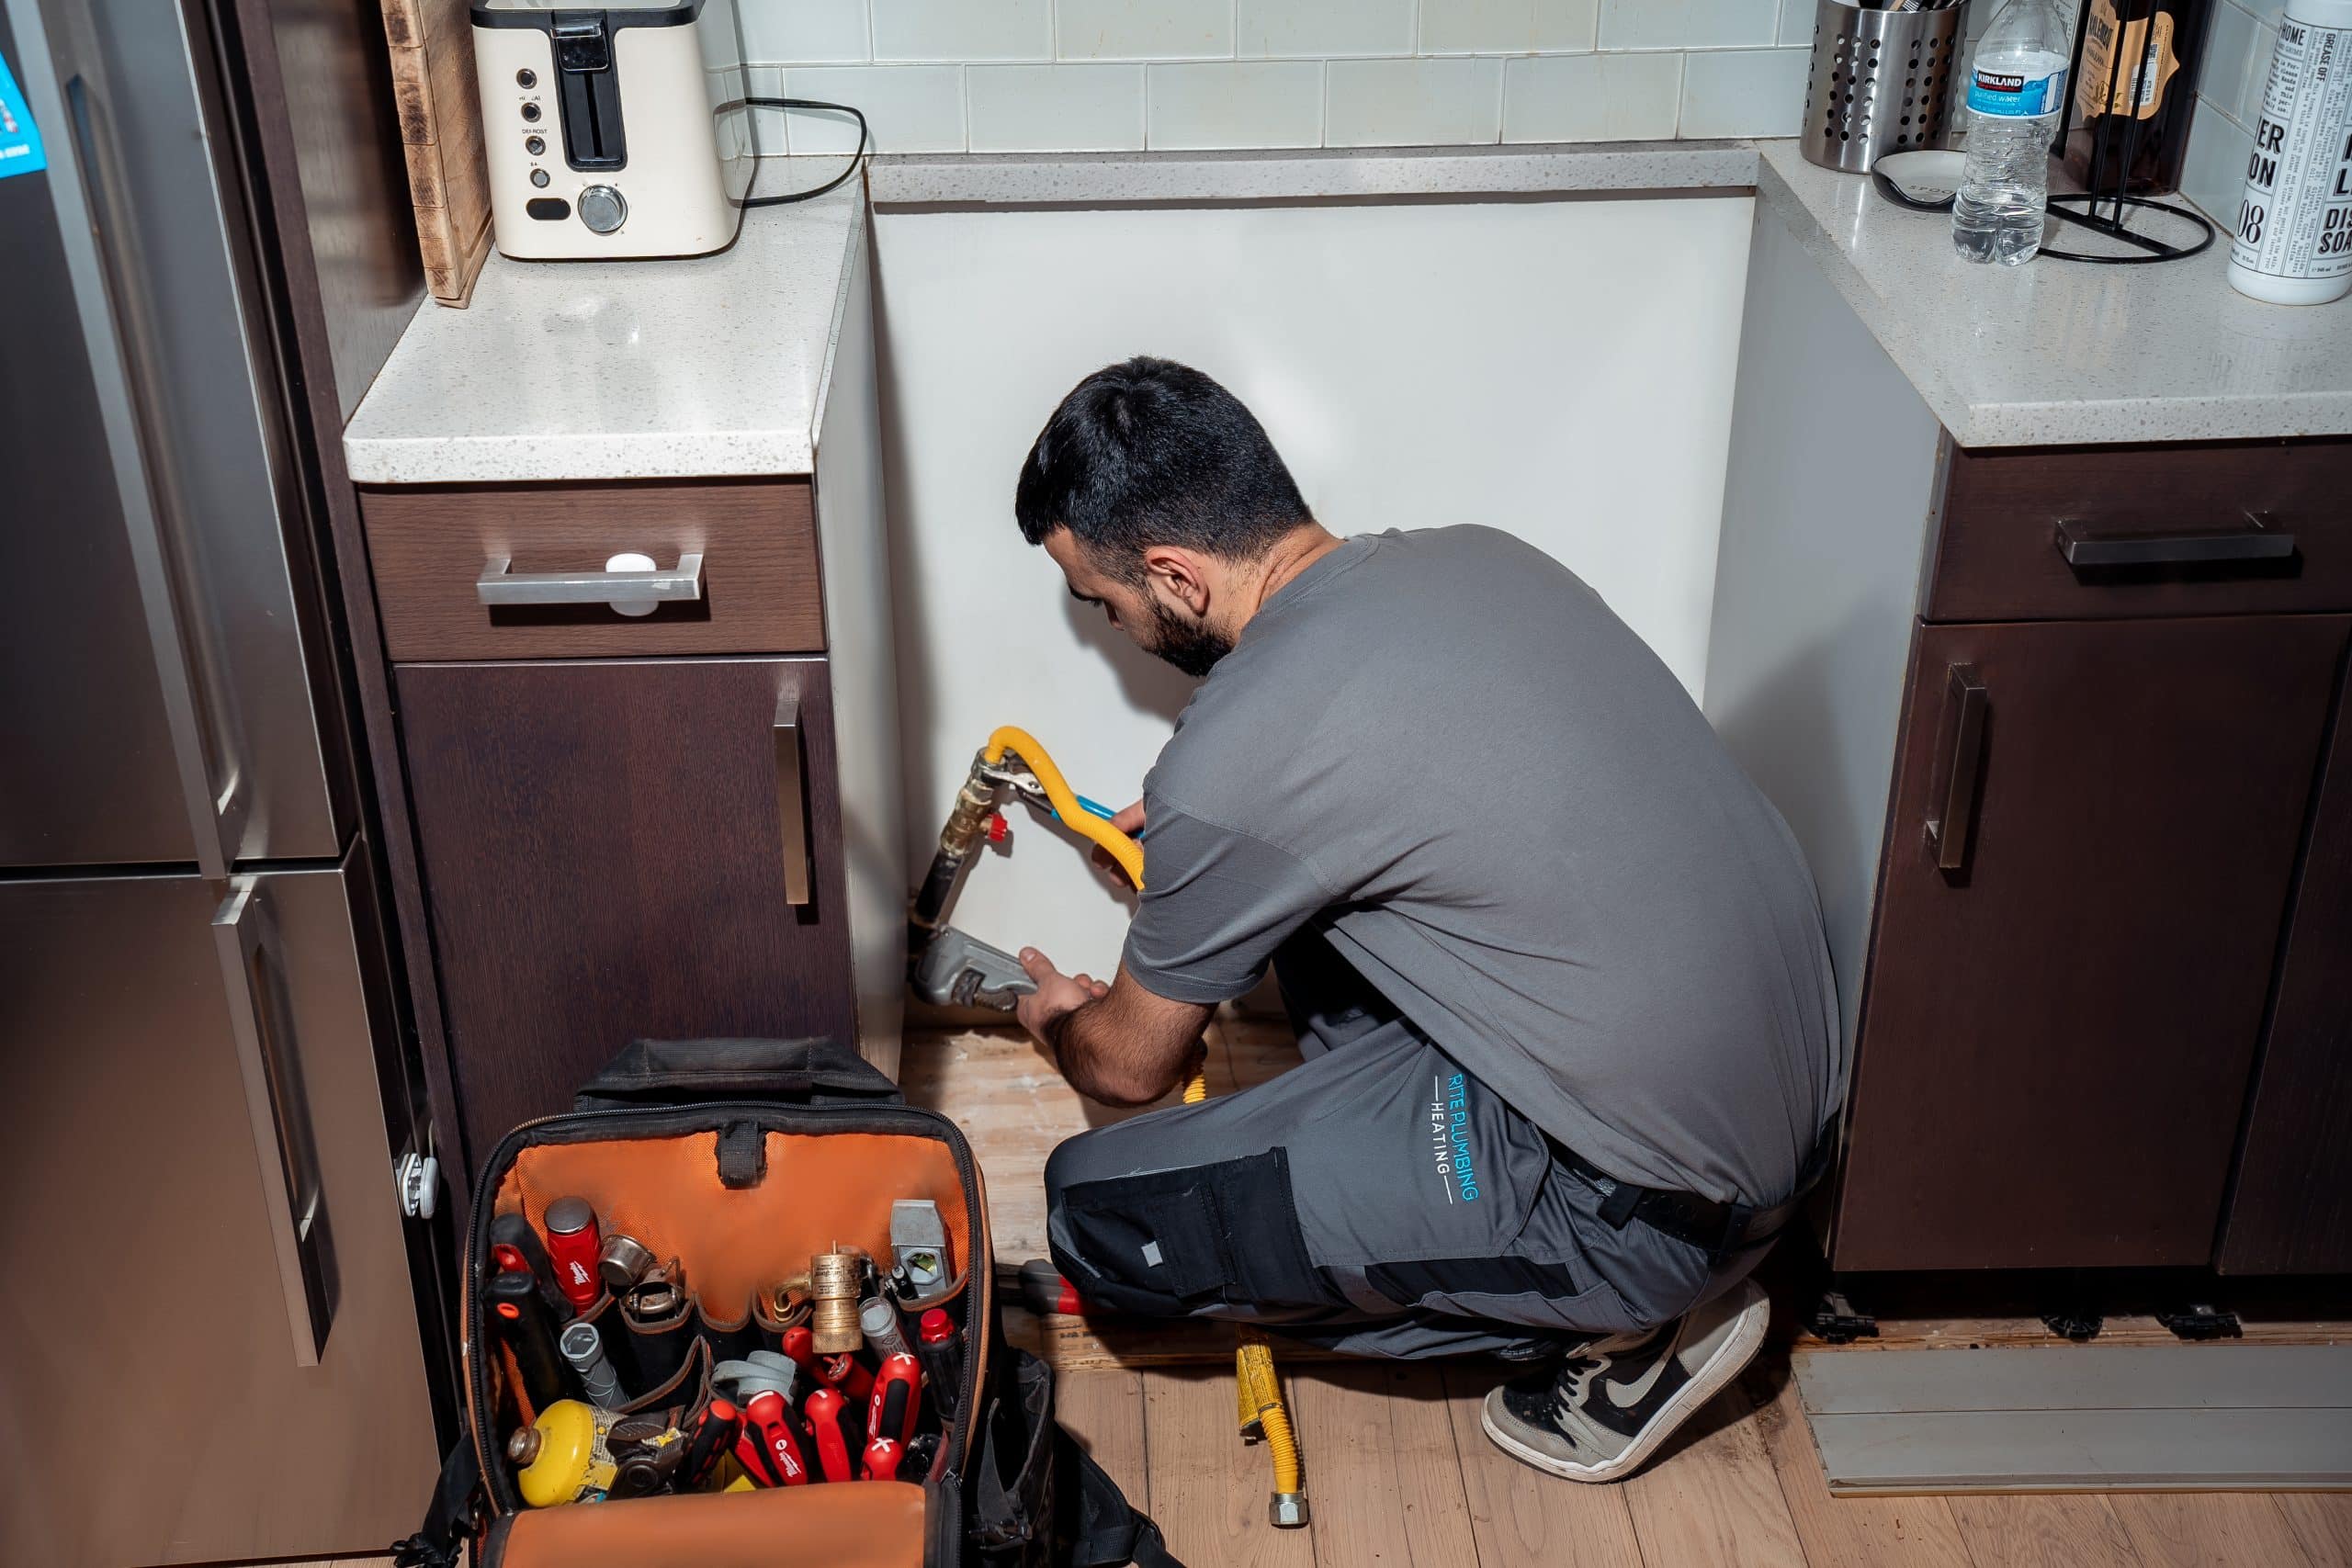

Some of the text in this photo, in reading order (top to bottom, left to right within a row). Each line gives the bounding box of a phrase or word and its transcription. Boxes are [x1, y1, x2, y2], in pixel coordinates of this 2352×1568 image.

[2319, 32, 2335, 65] GREASE
[1978, 73, 2021, 87] KIRKLAND
[2315, 66, 2327, 82] OFF
[2256, 118, 2285, 154] ER
[2248, 152, 2277, 187] ON
[1909, 185, 1953, 194] SPOO
[2238, 198, 2265, 243] 08
[1430, 1102, 1450, 1174] HEATING
[1448, 1073, 1479, 1202] RITE PLUMBING
